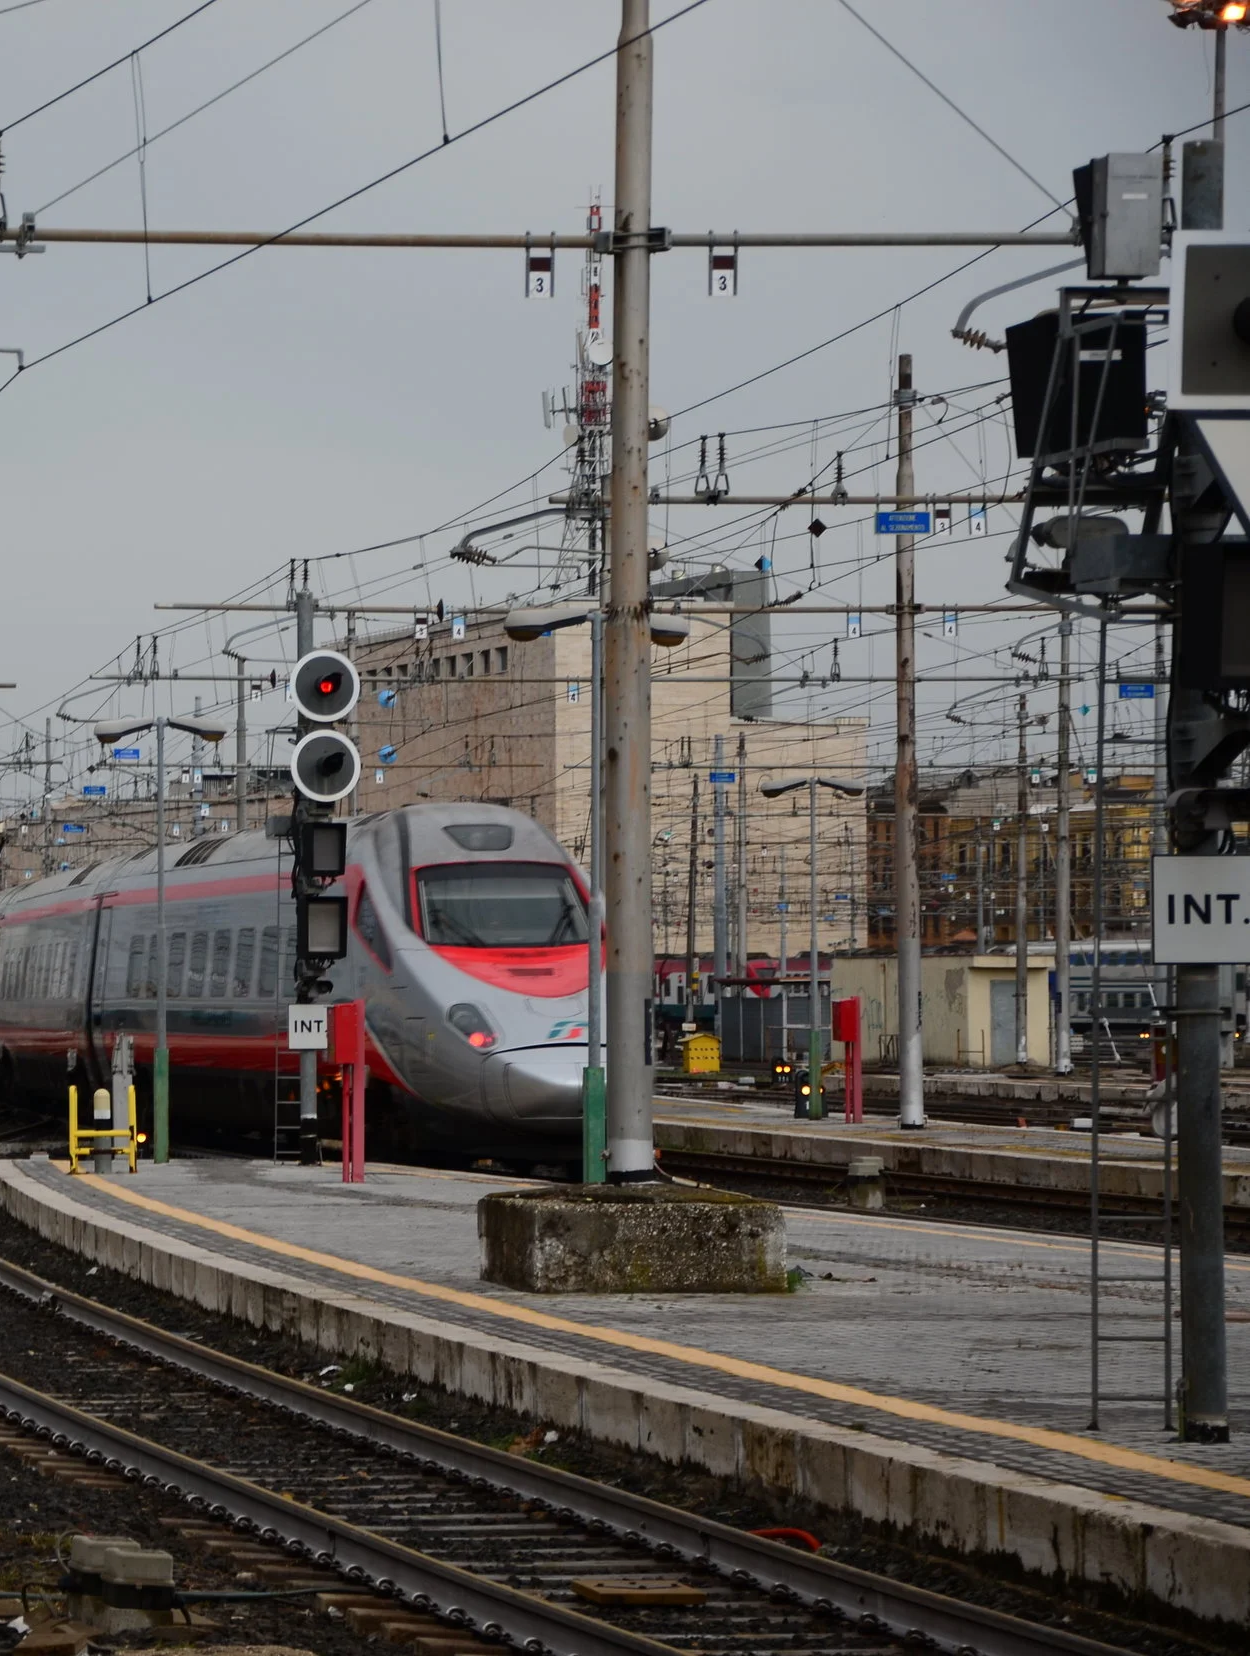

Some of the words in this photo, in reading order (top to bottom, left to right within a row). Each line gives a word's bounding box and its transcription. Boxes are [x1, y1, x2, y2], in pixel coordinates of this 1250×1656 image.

[535, 277, 544, 293] 3
[718, 275, 727, 291] 3
[975, 522, 981, 532] 4
[455, 628, 461, 637] 4
[851, 626, 857, 635] 4
[947, 626, 953, 635] 4
[1167, 894, 1250, 924] INT.
